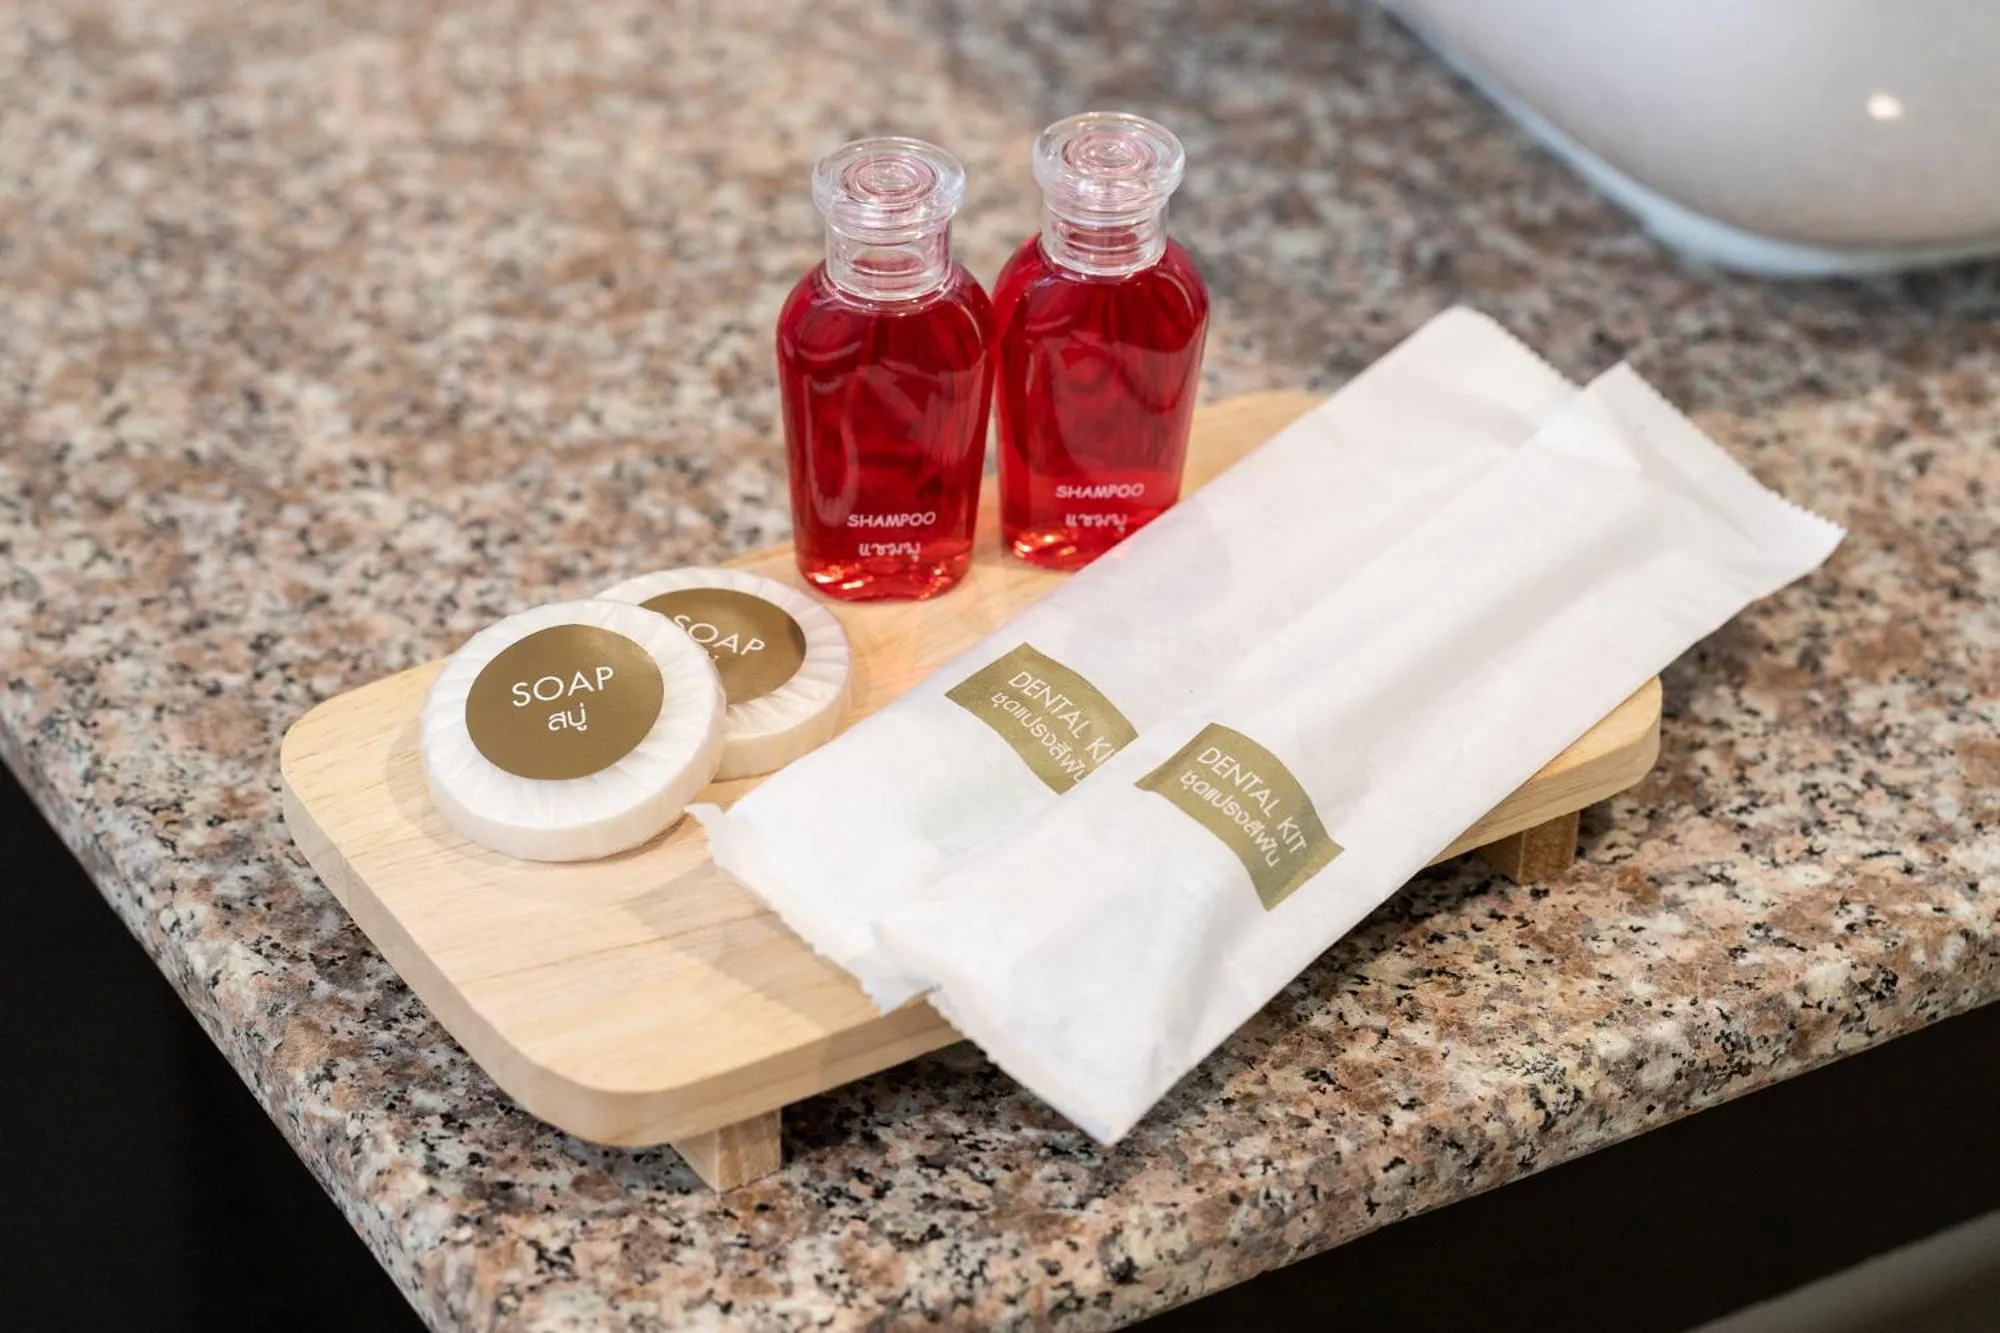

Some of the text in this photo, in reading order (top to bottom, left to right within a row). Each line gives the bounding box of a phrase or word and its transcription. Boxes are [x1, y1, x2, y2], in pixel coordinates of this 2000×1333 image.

[1055, 483, 1145, 499] SHAMPOO
[847, 511, 937, 528] SHAMPOO
[511, 665, 615, 708] SOAP
[547, 702, 588, 732] สบู่
[1008, 671, 1116, 765] DENTAL KI
[1196, 746, 1308, 855] DENTAL KIT
